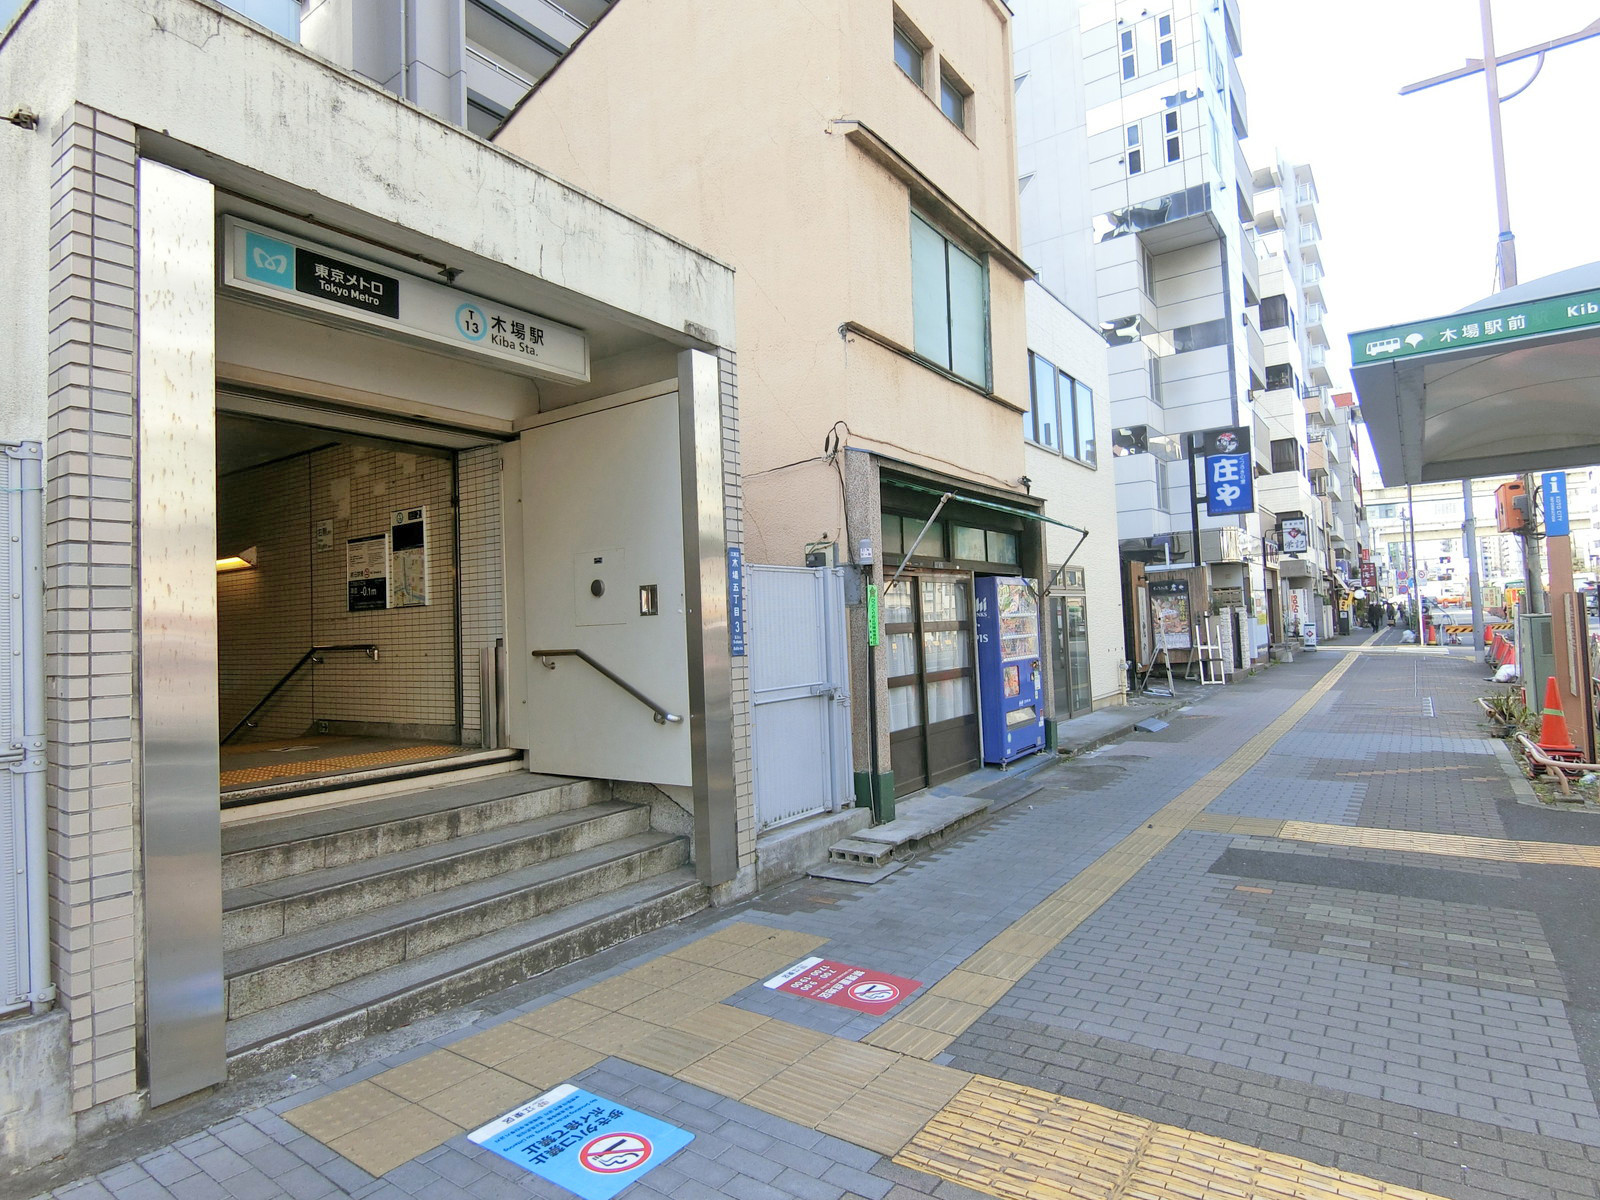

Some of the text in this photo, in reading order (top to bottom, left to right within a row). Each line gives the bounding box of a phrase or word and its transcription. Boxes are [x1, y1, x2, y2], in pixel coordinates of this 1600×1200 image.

[314, 262, 383, 295] 東京メトロ
[320, 279, 380, 307] Tokyo Metro
[464, 320, 480, 334] 13
[468, 309, 475, 321] T
[1439, 314, 1526, 343] 木場駅前
[491, 315, 544, 346] 木場駅
[491, 333, 539, 357] Kiba Sta.
[1213, 458, 1241, 507] 庄や
[502, 1106, 537, 1124] 江東区
[520, 1106, 605, 1156] ポイ捨て禁止
[528, 1108, 624, 1166] 歩きタバコ禁止
